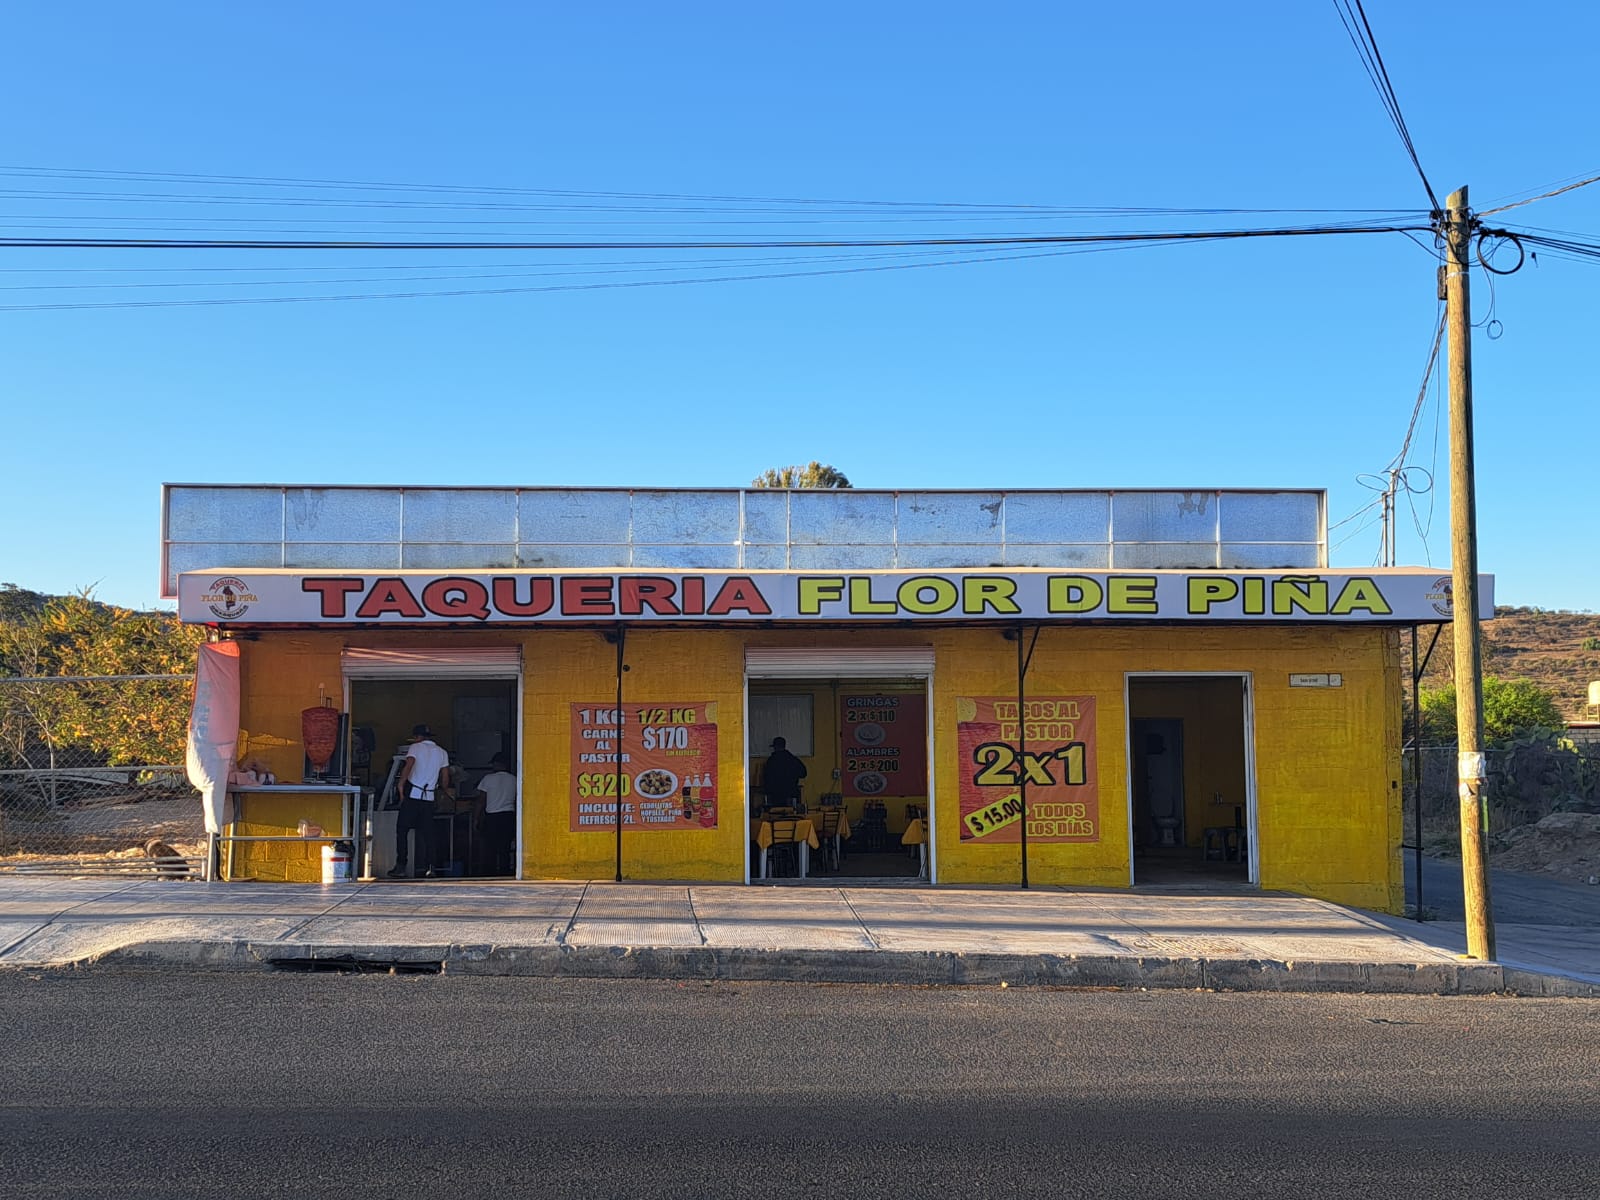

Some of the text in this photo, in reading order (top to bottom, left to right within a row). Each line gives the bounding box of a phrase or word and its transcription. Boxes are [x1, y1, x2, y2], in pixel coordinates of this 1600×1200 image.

[302, 574, 1393, 620] TAQUERIA FLOR DE PIÑA
[847, 697, 899, 708] GRINGAS
[994, 702, 1080, 719] TACOS AL
[579, 709, 626, 725] 1 KG
[637, 709, 696, 724] 1/2 KG
[847, 710, 858, 722] 2
[595, 741, 611, 750] AL
[642, 726, 688, 751] $170
[847, 747, 900, 757] ALAMBRES
[847, 760, 858, 772] 2
[973, 742, 1087, 786] 2x1
[578, 772, 631, 798] $320
[1033, 803, 1085, 819] TODOS
[579, 815, 618, 825] REFRESC
[1026, 818, 1093, 836] LOS DÍAS
